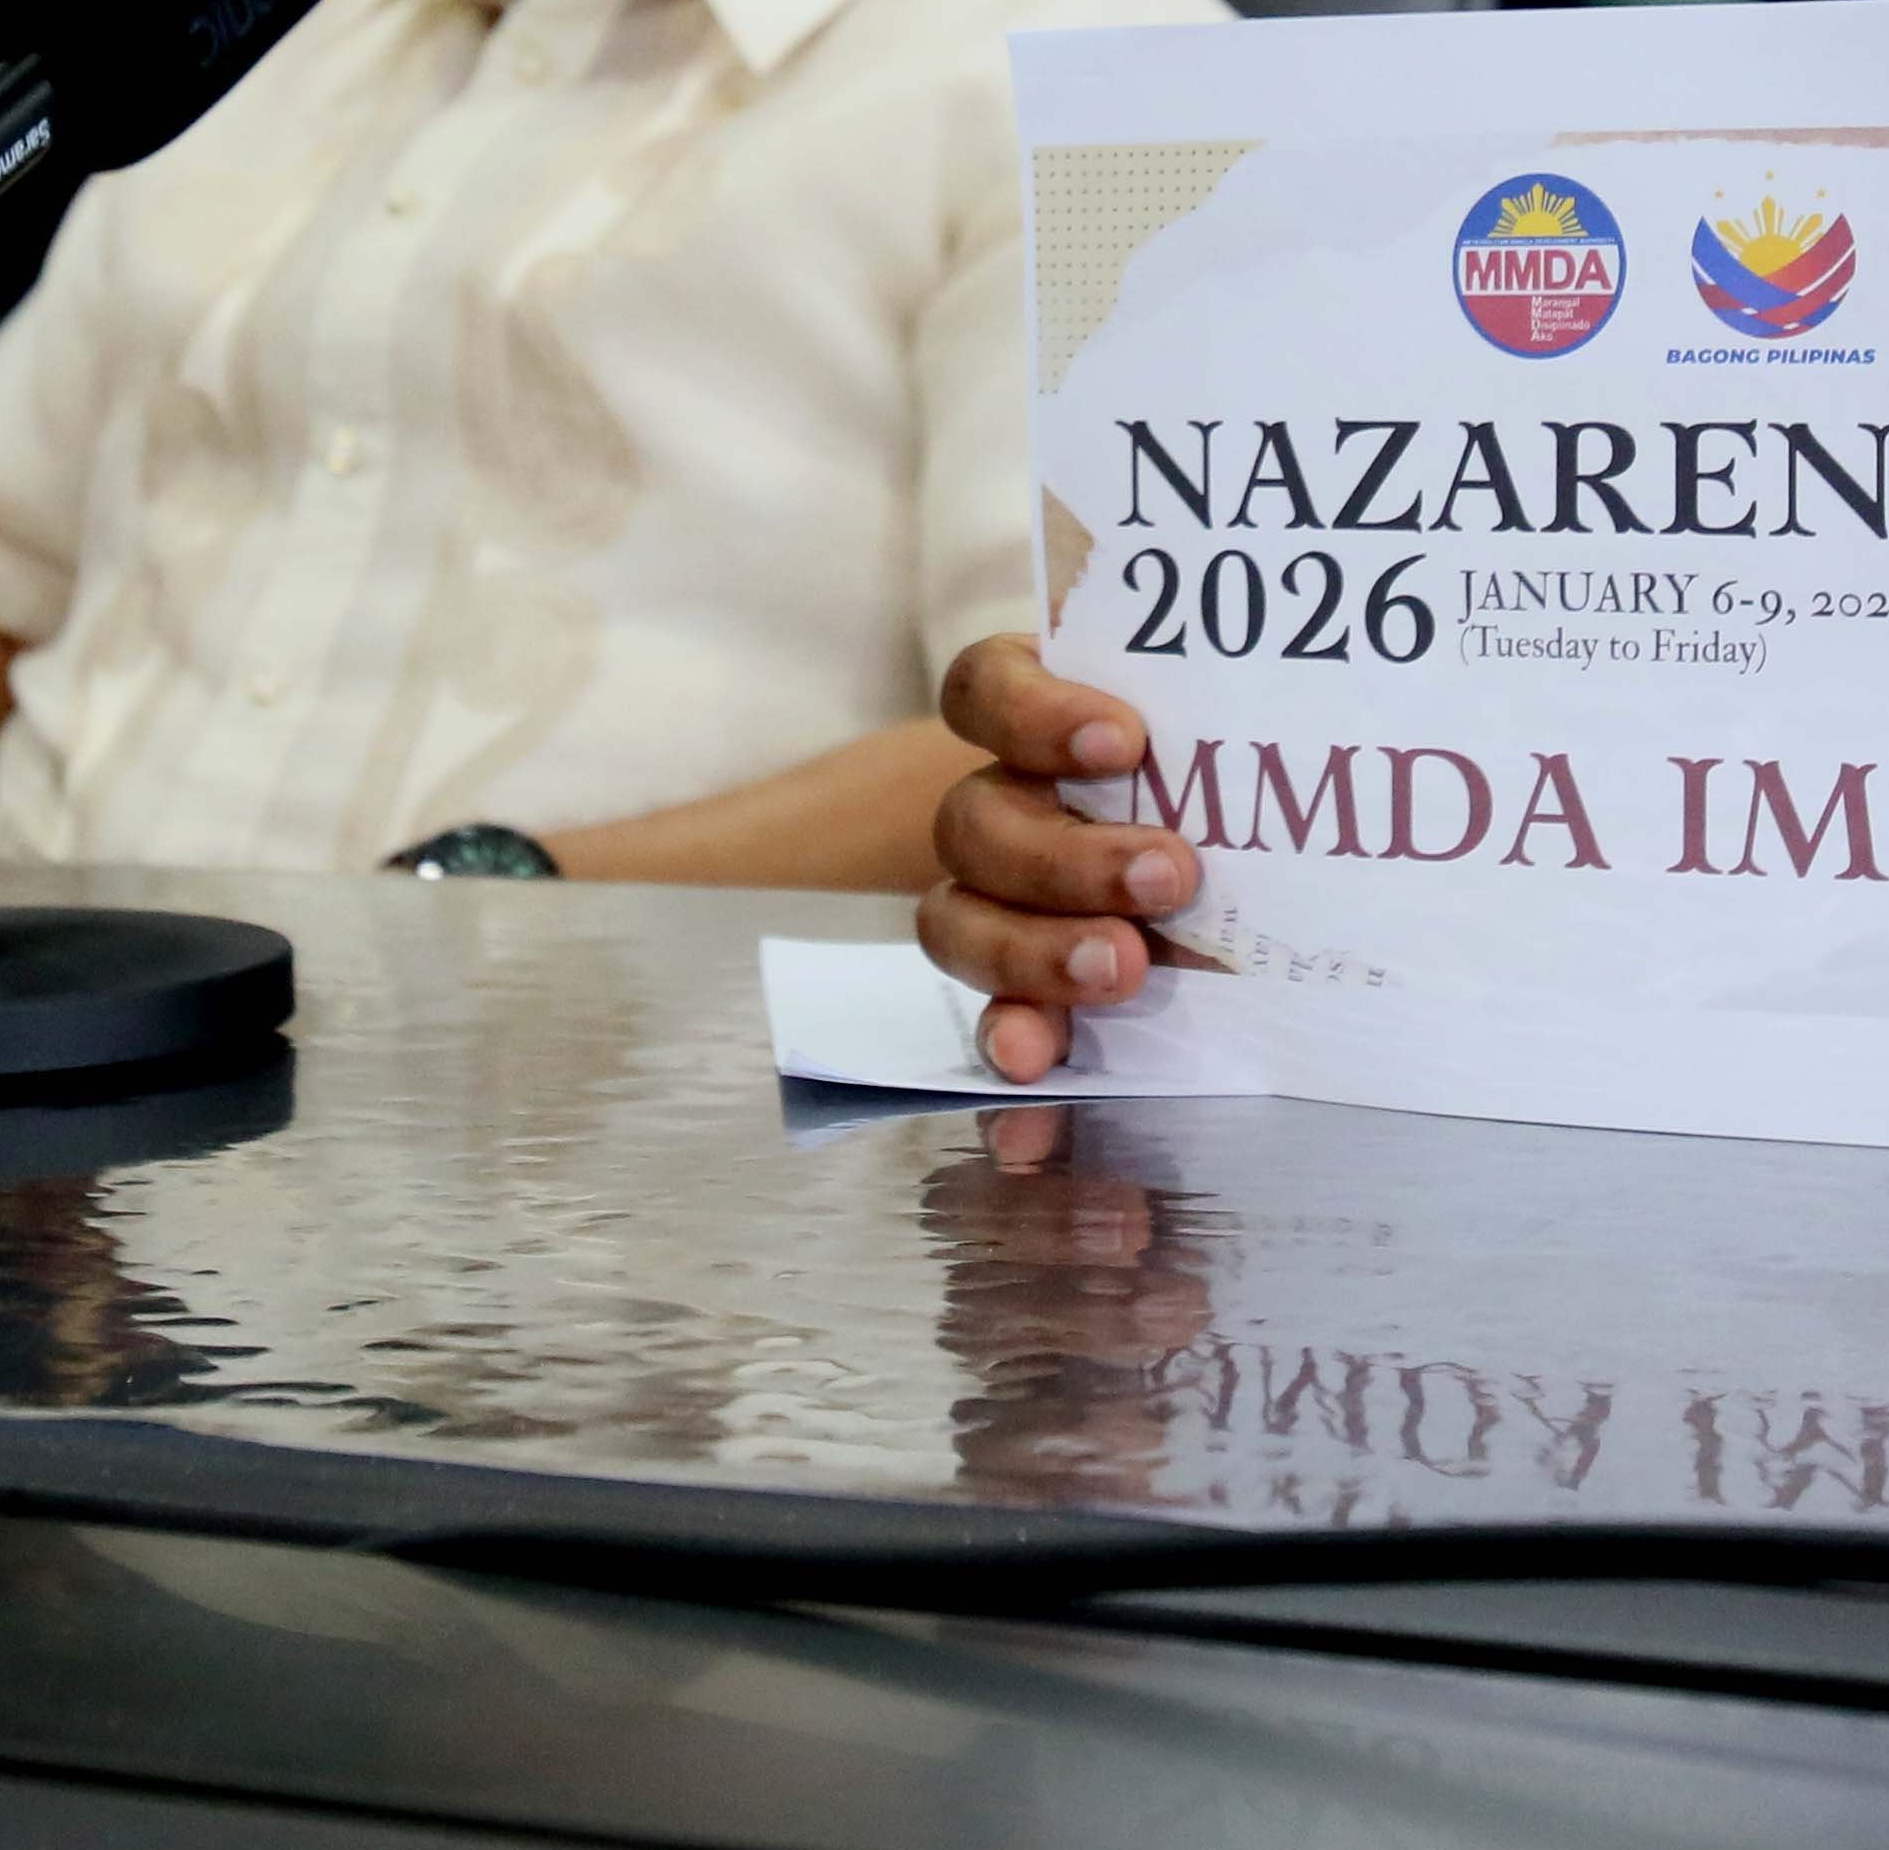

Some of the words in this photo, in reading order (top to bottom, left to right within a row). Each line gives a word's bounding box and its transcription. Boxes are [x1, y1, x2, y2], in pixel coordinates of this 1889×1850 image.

[1465, 249, 1613, 291] MMDA
[1666, 349, 1761, 365] BAGONG
[1766, 349, 1876, 365] PILIPINAS
[1122, 547, 1436, 664] 2026
[1457, 569, 1700, 626] JANUARY
[1711, 580, 1797, 626] 6-9,
[1458, 623, 1600, 670] (Tuesday
[1608, 633, 1641, 661] to
[1651, 628, 1770, 676] Friday)
[1131, 738, 1611, 871] MMDA
